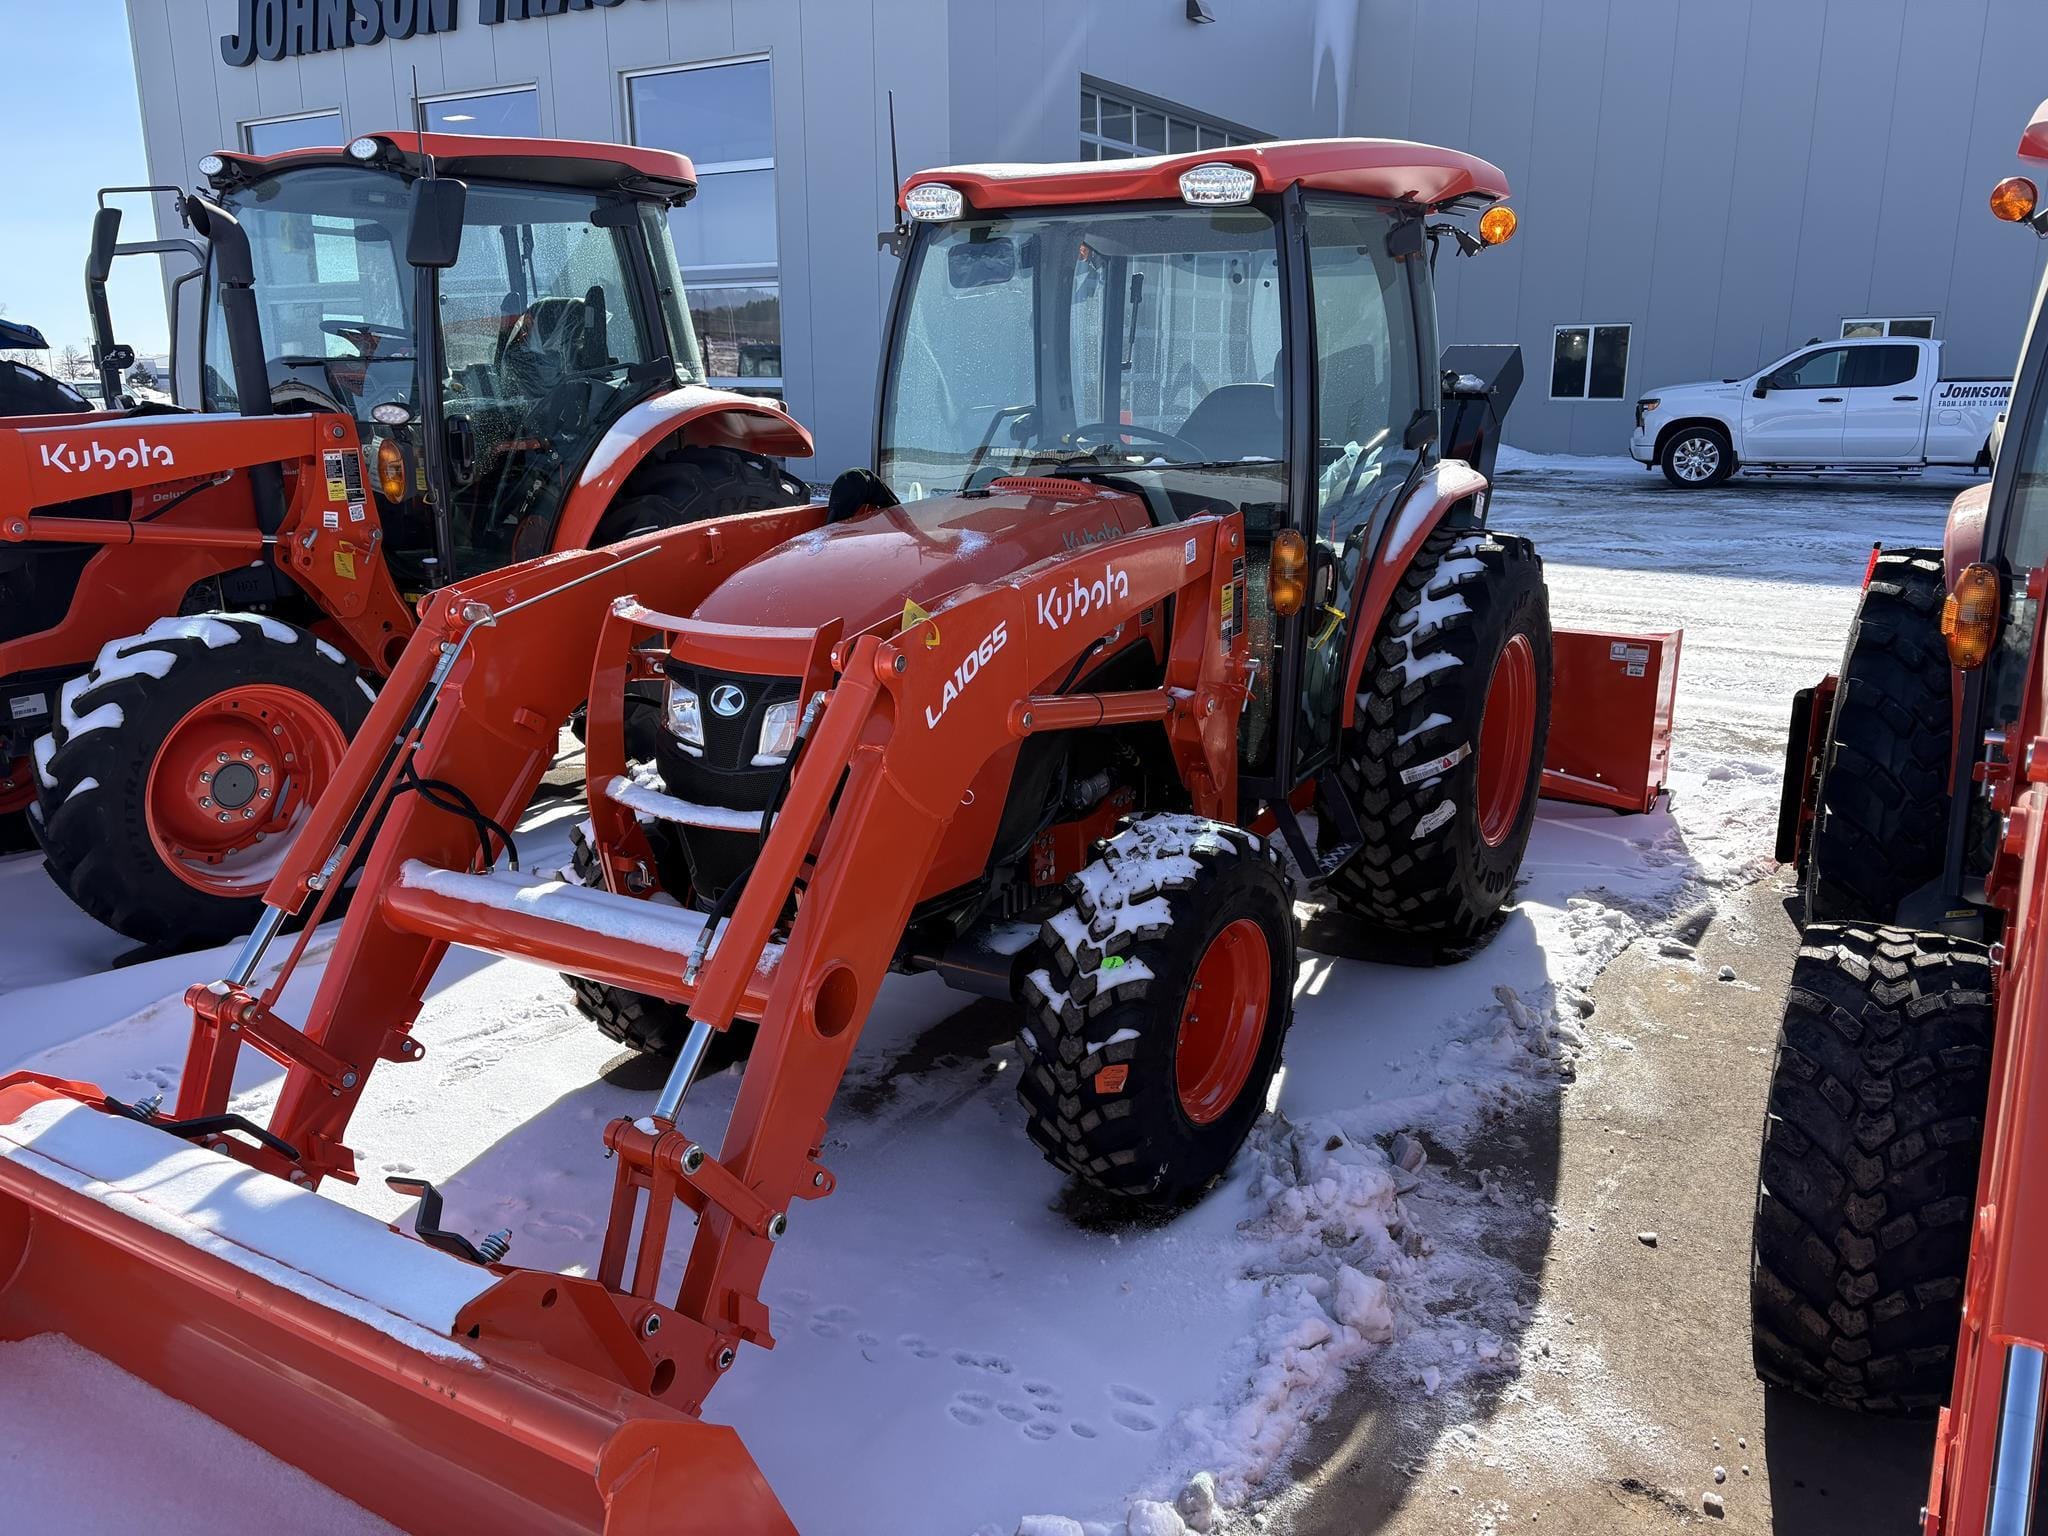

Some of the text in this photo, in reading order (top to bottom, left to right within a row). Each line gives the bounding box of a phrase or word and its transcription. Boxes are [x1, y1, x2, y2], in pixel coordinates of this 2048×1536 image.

[1940, 384, 2012, 398] JOHNSON
[40, 438, 174, 474] Kubota
[1037, 564, 1129, 631] Kubota
[925, 620, 1008, 730] LA1065
